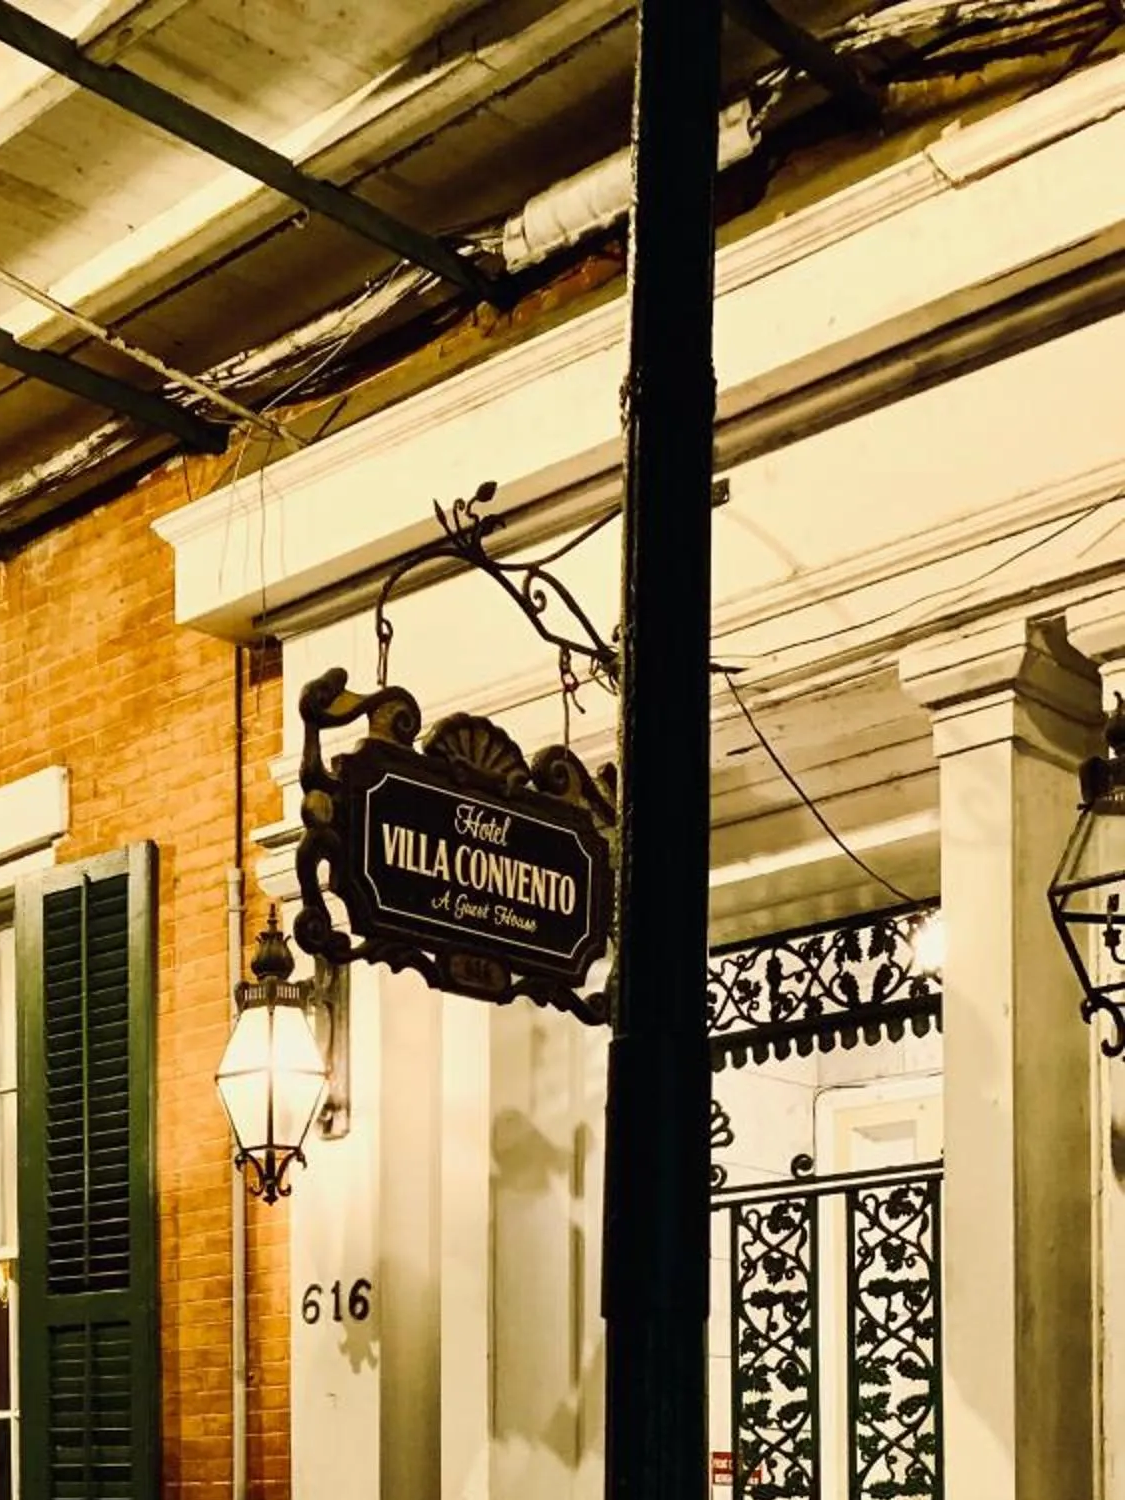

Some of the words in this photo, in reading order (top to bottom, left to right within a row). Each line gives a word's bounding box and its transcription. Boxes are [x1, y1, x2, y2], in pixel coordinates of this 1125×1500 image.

[454, 803, 512, 847] Hotel
[382, 823, 450, 881] VILLA
[455, 845, 576, 915] CONVENTO
[431, 889, 451, 911] A
[454, 893, 490, 920] Guest
[494, 905, 538, 934] House
[302, 1277, 373, 1325] 616
